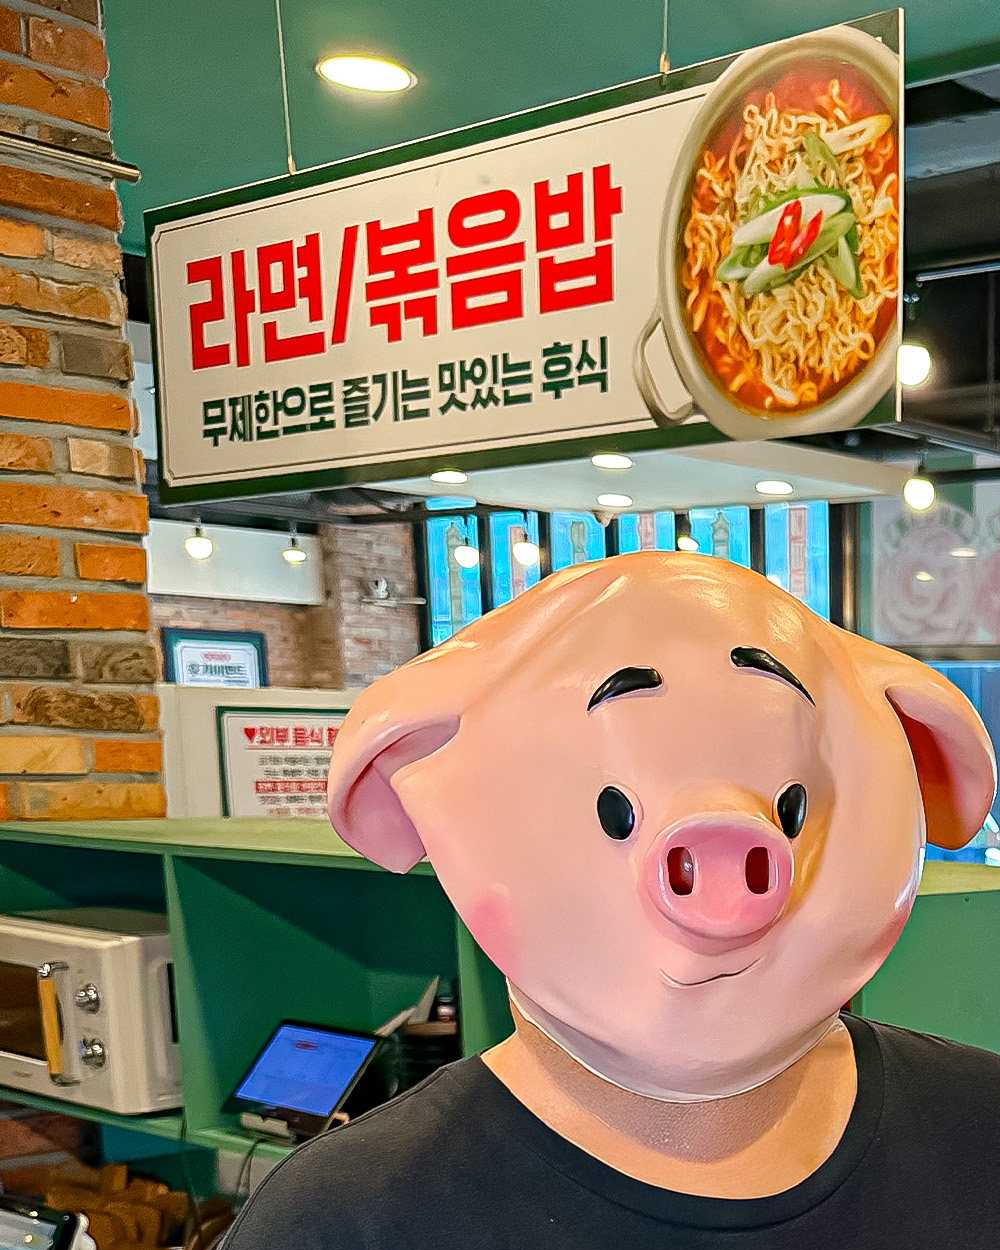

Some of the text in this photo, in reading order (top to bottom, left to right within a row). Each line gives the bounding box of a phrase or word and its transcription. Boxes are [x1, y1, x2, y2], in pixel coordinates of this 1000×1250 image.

[186, 163, 623, 370] 라면/볶음밥
[201, 336, 609, 447] 무제한으로 즐기는 맛있는 후식
